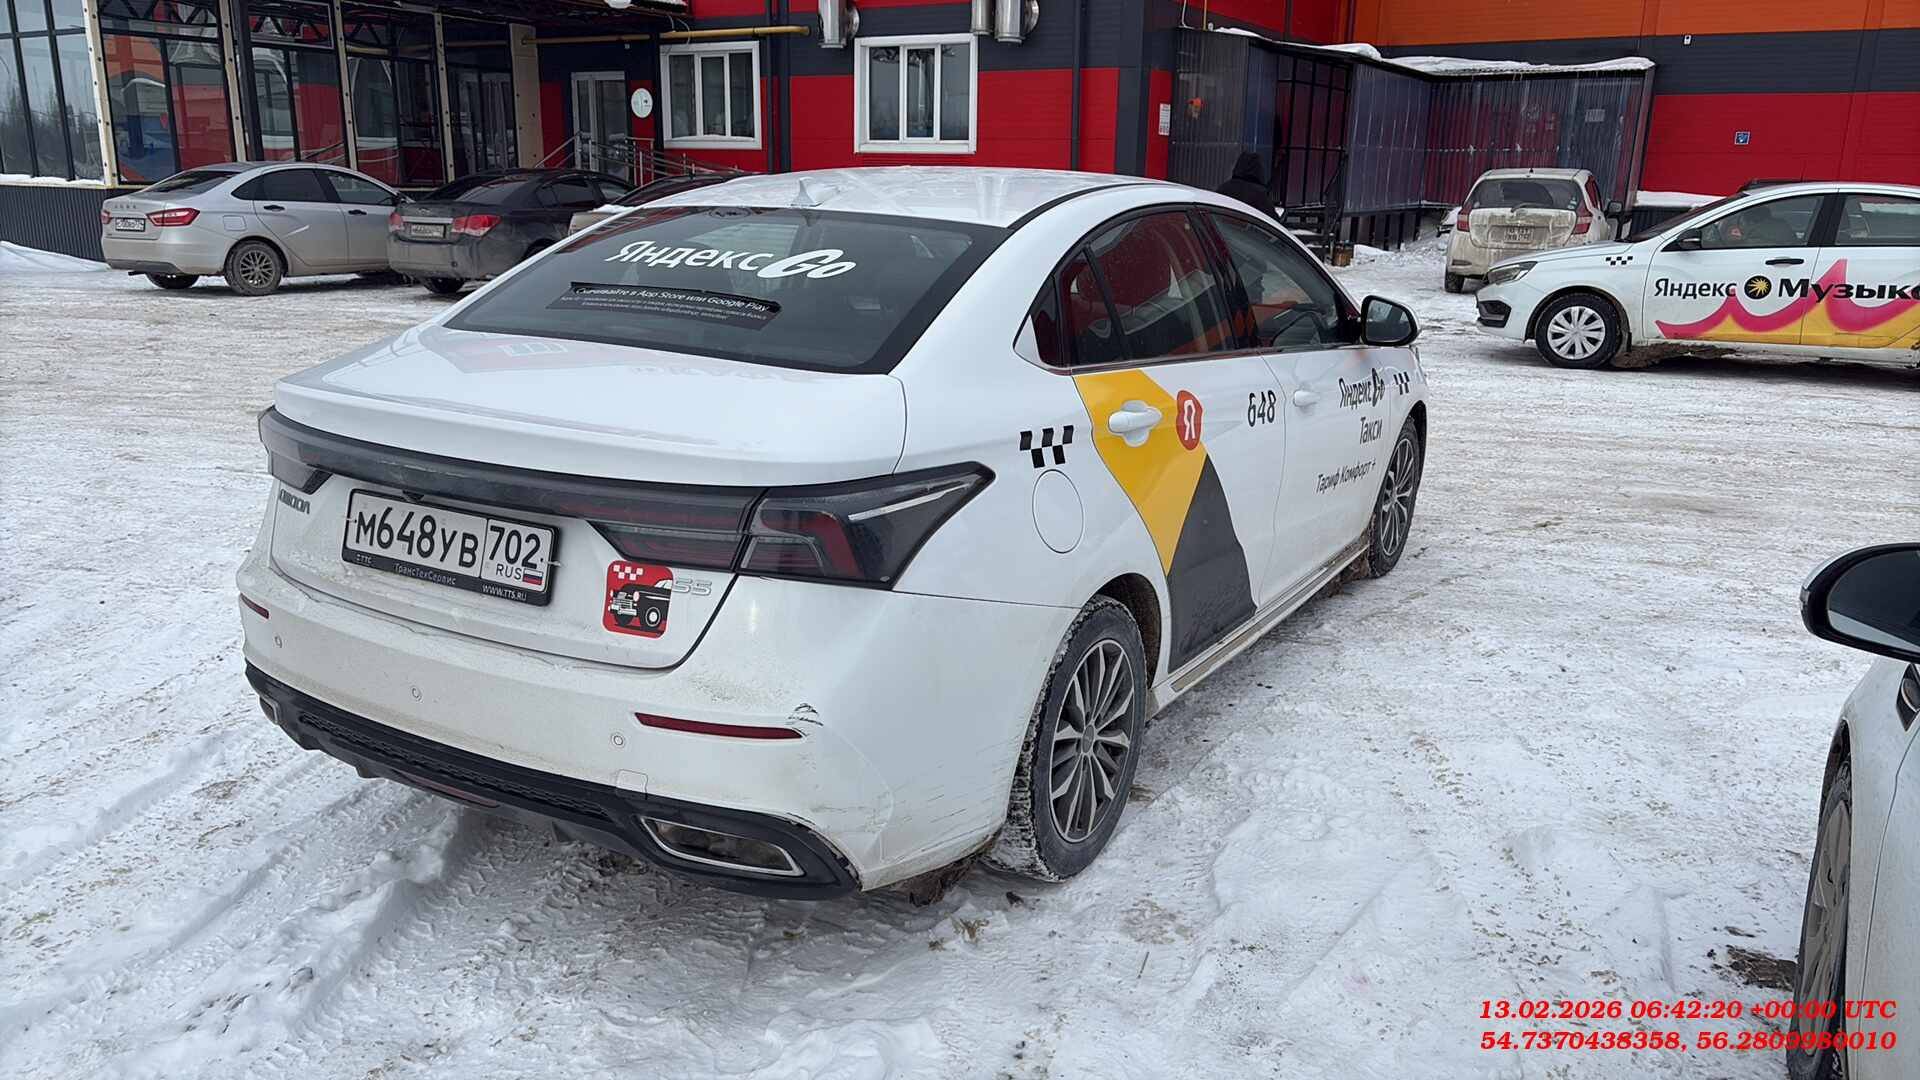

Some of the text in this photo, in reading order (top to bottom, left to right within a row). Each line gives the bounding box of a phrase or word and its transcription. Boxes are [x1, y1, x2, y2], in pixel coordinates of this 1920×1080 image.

[605, 240, 857, 279] Яндекс Go
[637, 290, 659, 301] App
[658, 291, 687, 301] Store
[686, 295, 708, 303] или
[707, 297, 745, 309] Google
[745, 302, 770, 313] Play
[1654, 278, 1737, 300] Яндекс
[1247, 389, 1277, 428] 648
[1339, 378, 1372, 410] Яндекс
[1183, 399, 1196, 441] Я
[1360, 416, 1383, 445] Такси
[1316, 468, 1341, 494] Тариф
[1340, 460, 1373, 484] Комфорт
[356, 506, 541, 570] М648УВ 702
[393, 562, 457, 586] ТрансТехСервис
[495, 563, 522, 581] RUS
[481, 583, 528, 602] WWW.TTS.RU
